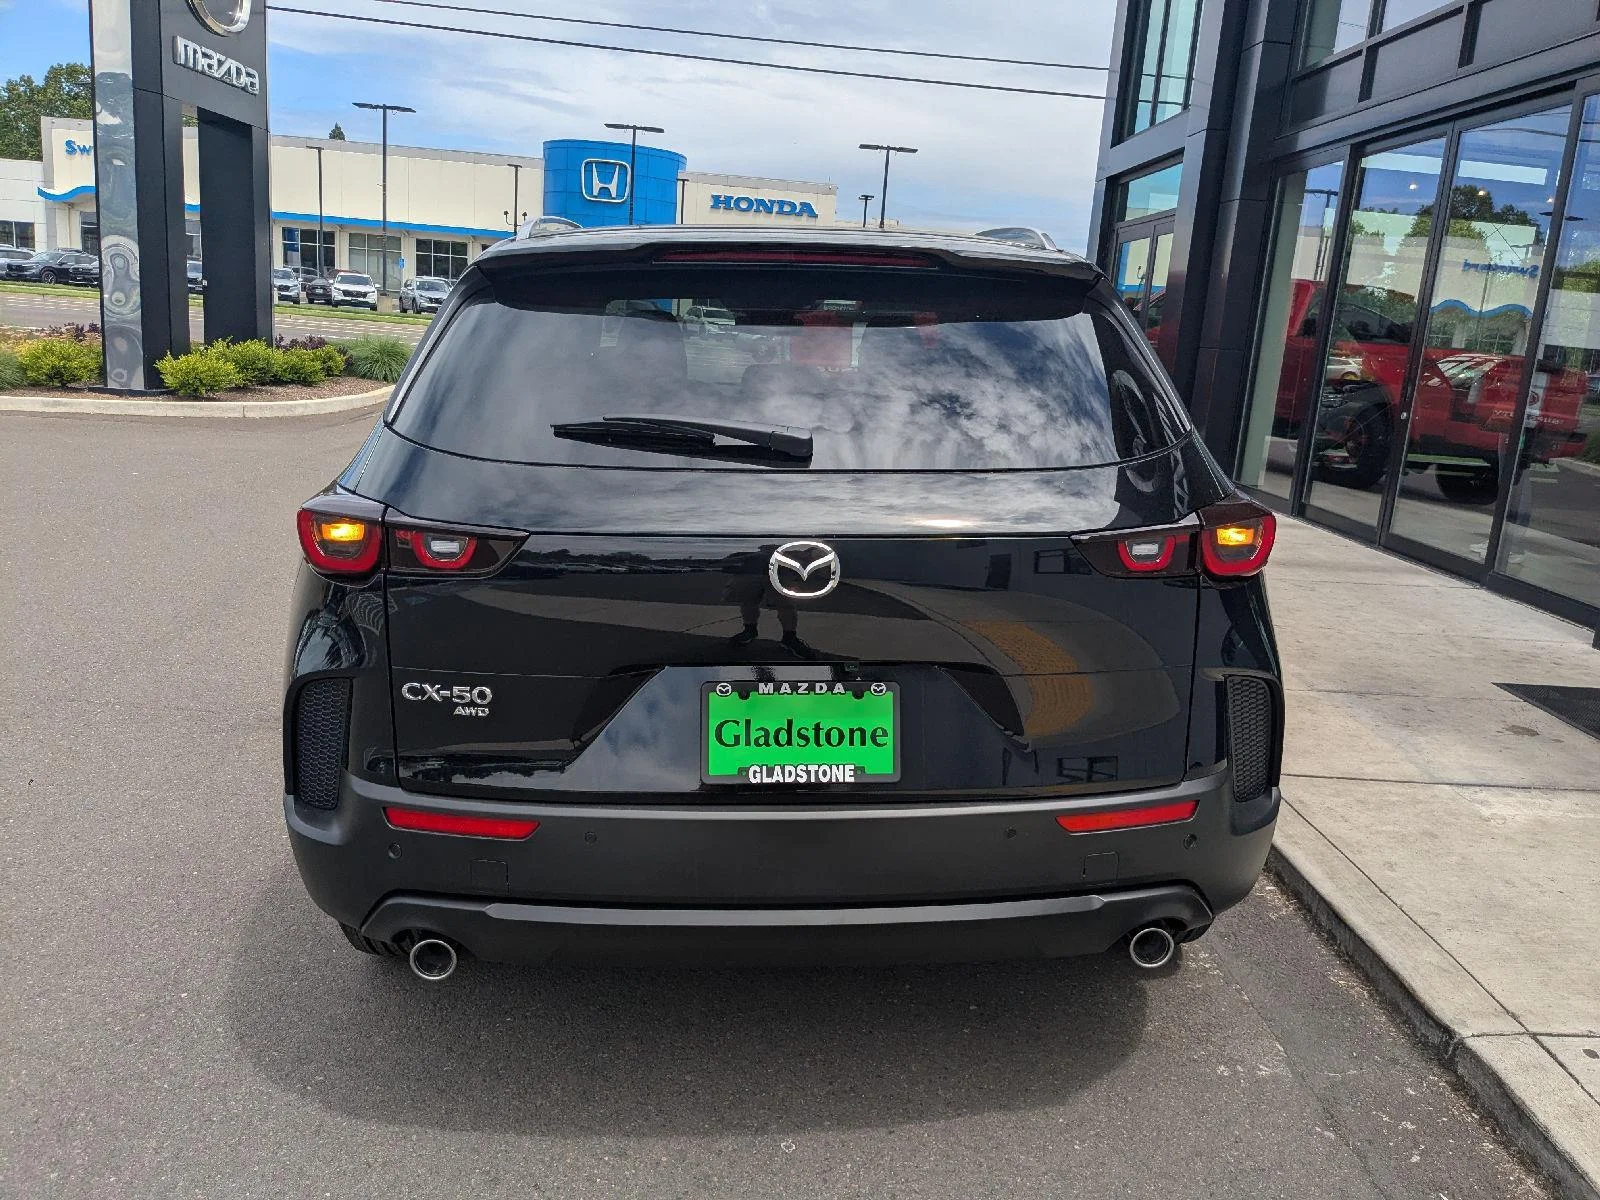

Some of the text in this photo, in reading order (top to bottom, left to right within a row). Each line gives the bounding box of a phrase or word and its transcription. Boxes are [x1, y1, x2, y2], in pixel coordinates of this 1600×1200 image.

[710, 194, 818, 218] HONDA
[401, 682, 493, 705] CX-50
[758, 682, 846, 694] MAZDA
[453, 706, 490, 716] AWD
[714, 718, 889, 748] Gladstone
[748, 764, 856, 784] GLADSTONE
